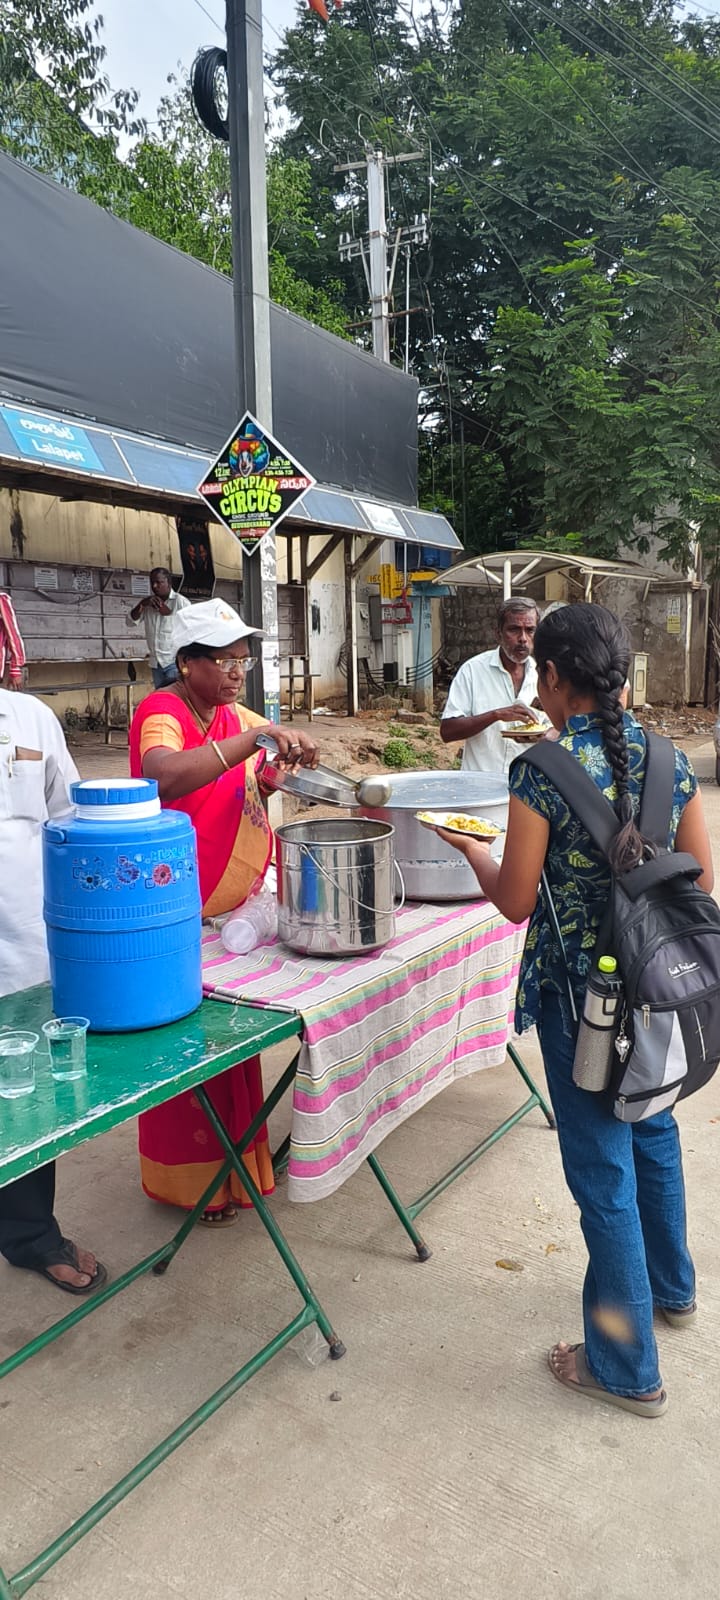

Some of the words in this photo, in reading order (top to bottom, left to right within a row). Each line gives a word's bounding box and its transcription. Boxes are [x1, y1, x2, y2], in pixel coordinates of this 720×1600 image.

[31, 438, 86, 462] Lalapet
[222, 475, 279, 496] OLYMPIAN
[219, 489, 282, 516] CIRCUS
